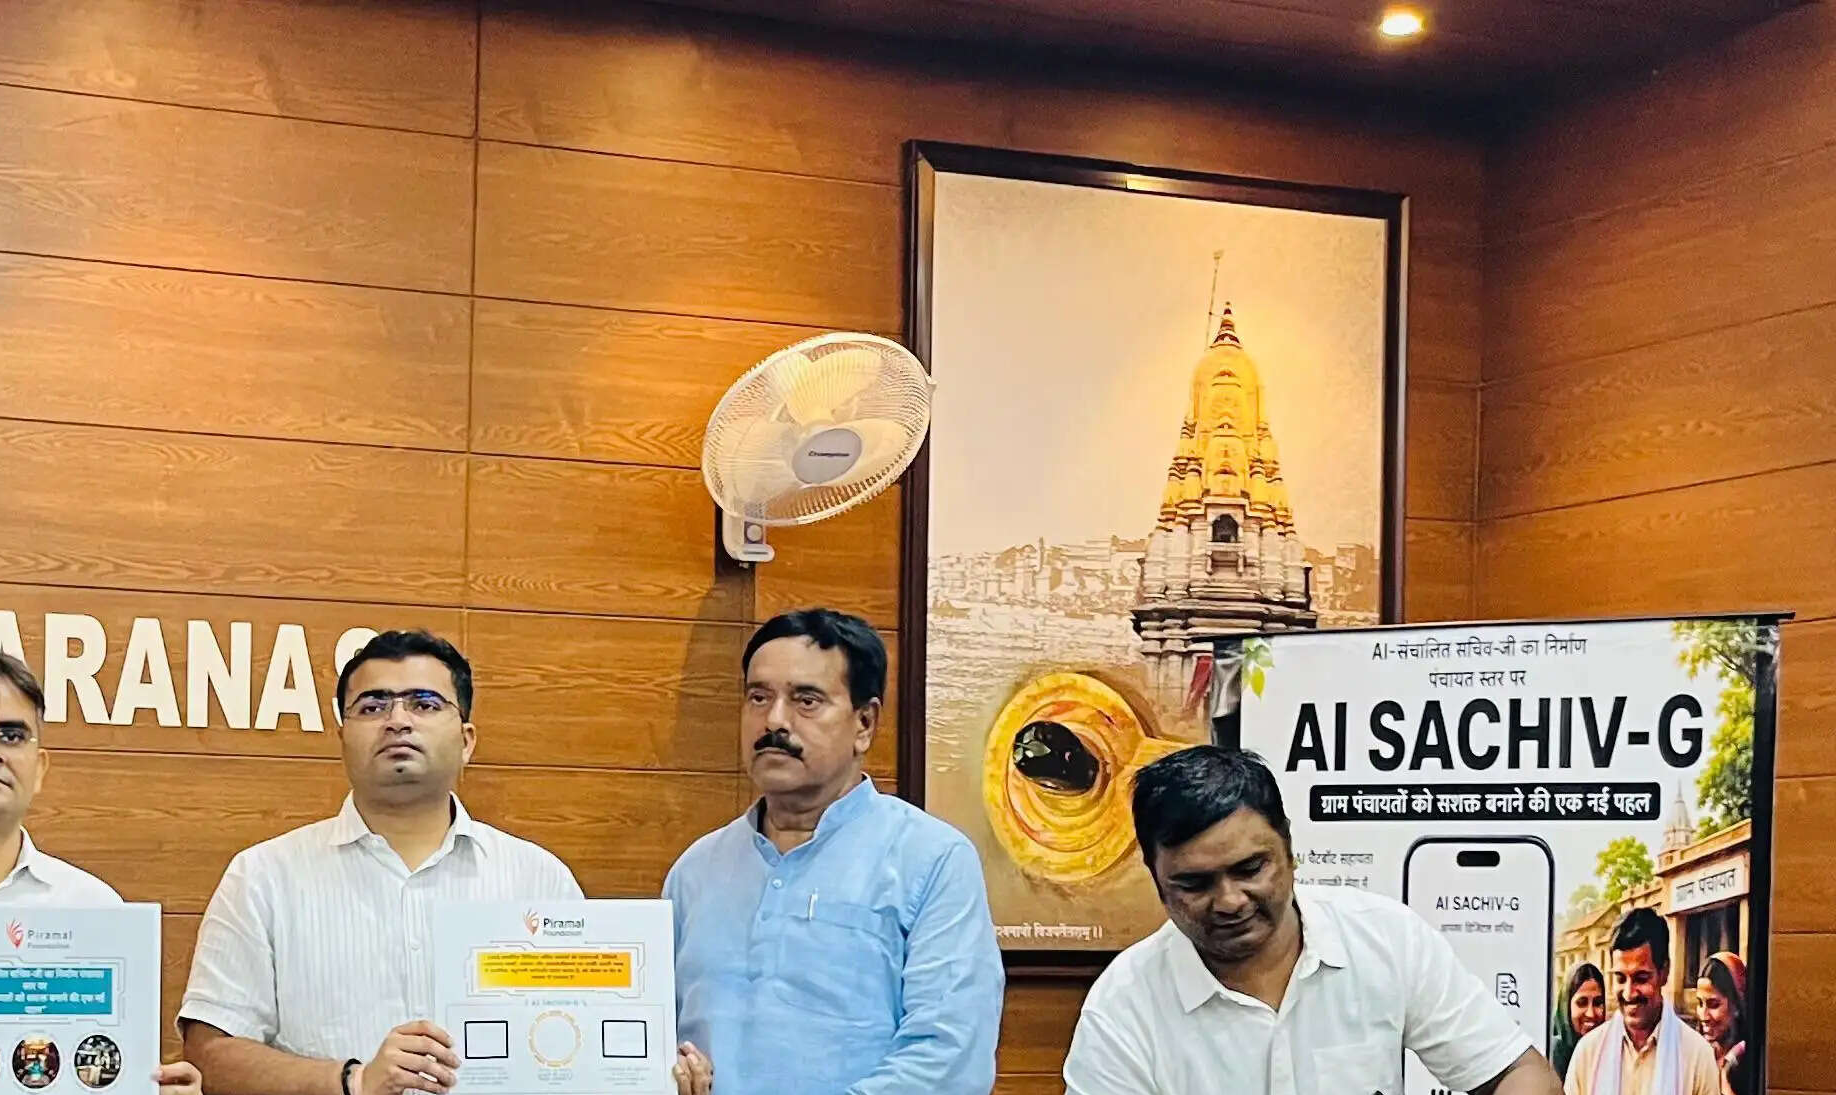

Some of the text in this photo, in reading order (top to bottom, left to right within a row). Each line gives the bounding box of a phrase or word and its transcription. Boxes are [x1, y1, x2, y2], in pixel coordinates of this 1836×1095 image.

[1372, 633, 1588, 660] AI-संचालित सचिव-जी का निर्माण
[1429, 668, 1527, 688] पंचायत स्तर पर
[1285, 694, 1704, 772] AI SACHIV-G
[1321, 787, 1652, 815] ग्राम पंचायतों को सशक्त बनाने की एक नई पहल
[1436, 896, 1520, 911] AI SACHIV-G
[543, 917, 585, 929] Piramal
[27, 929, 72, 940] Piramal
